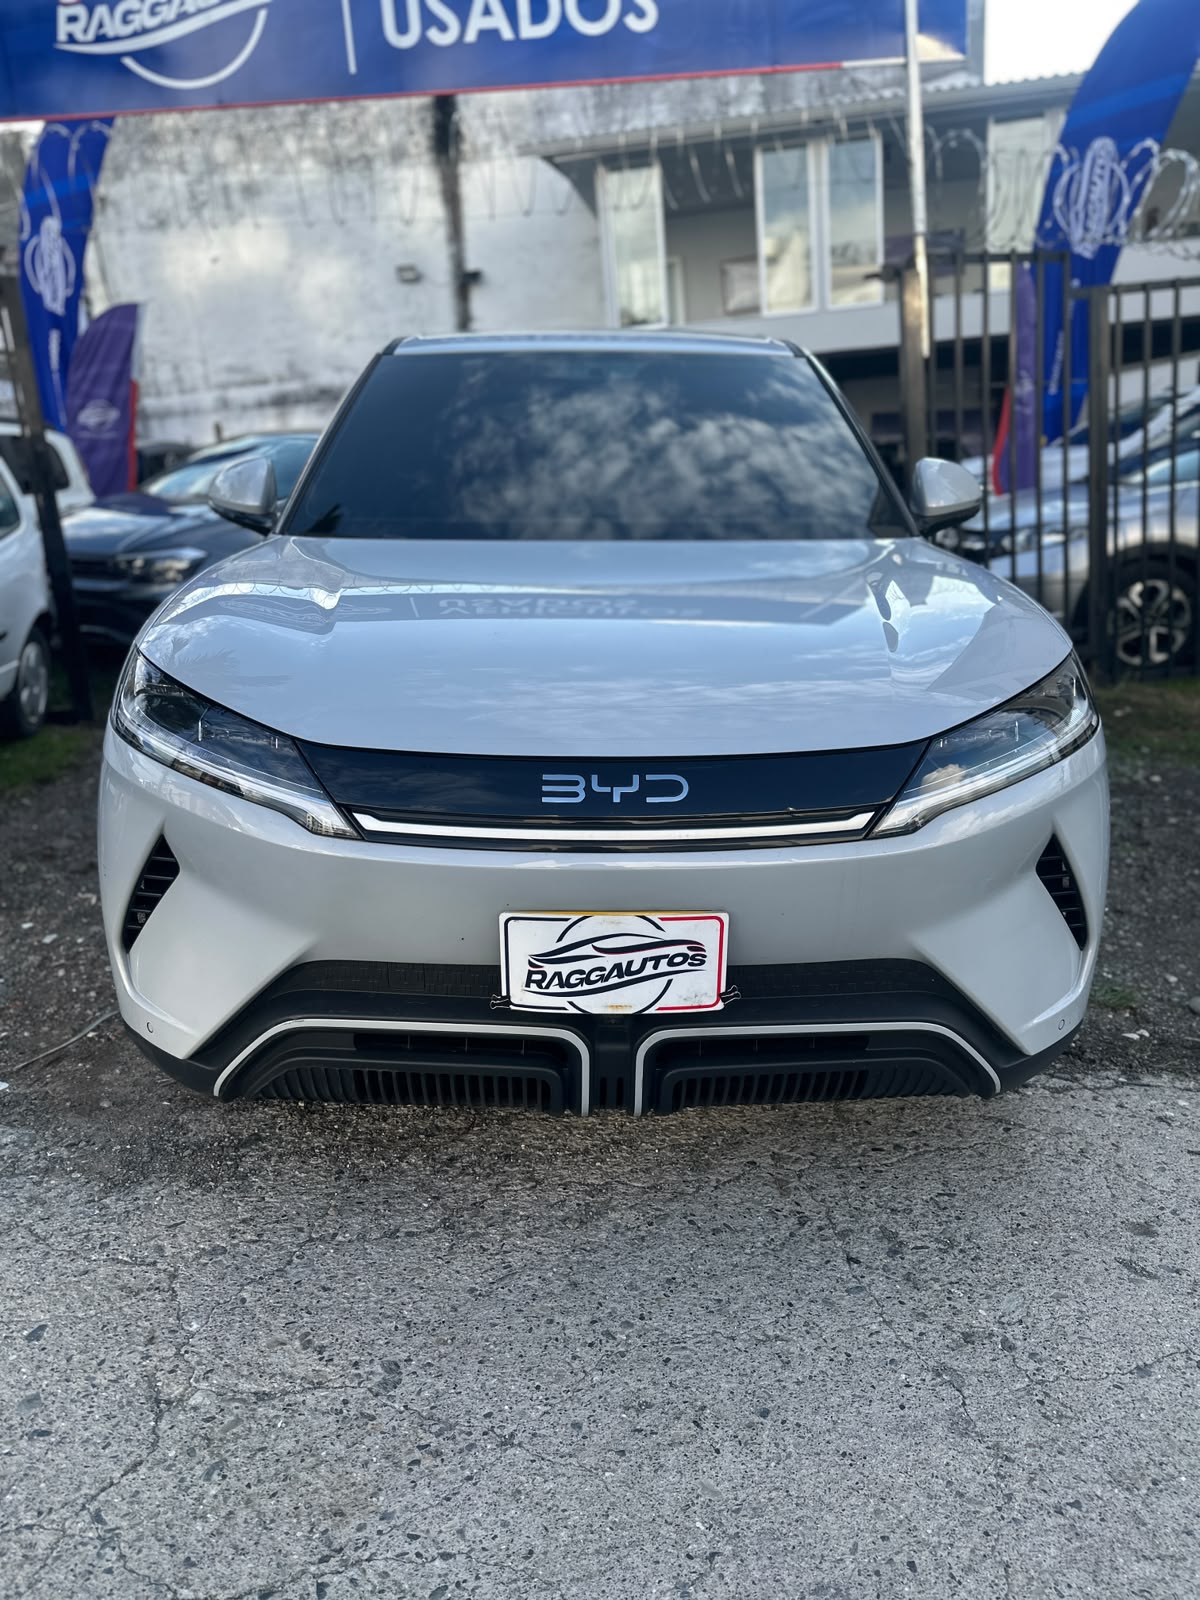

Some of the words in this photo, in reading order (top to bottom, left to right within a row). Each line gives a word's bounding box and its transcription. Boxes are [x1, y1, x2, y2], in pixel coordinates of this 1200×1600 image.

[380, 0, 660, 49] USADOS
[541, 774, 689, 803] BYD
[524, 952, 708, 990] RAGGAUTOS
